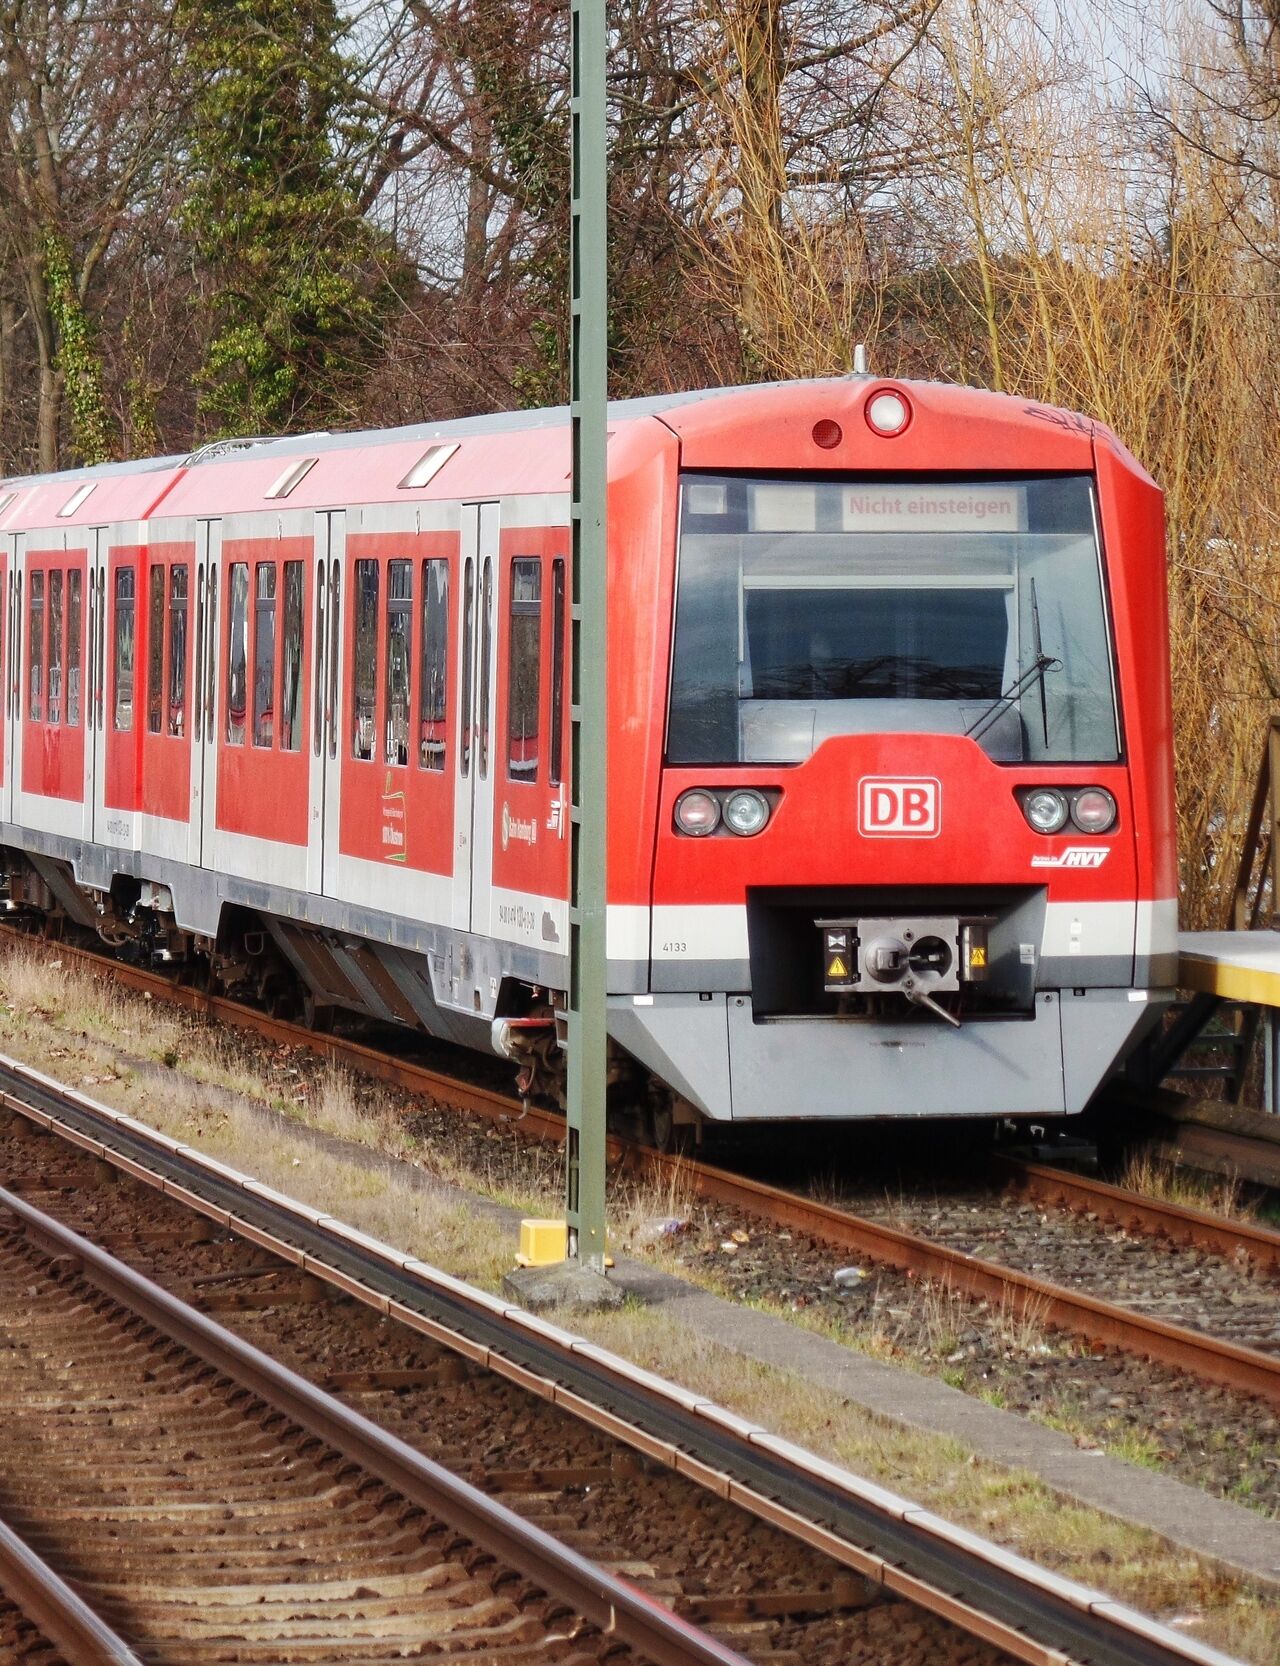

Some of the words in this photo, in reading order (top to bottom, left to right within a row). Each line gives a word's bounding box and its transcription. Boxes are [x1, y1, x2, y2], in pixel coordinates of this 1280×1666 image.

[849, 496, 902, 514] Nicht
[907, 496, 1012, 518] einsteigen
[870, 788, 930, 826] DB
[1066, 851, 1108, 866] HVV
[662, 942, 687, 952] 4133
